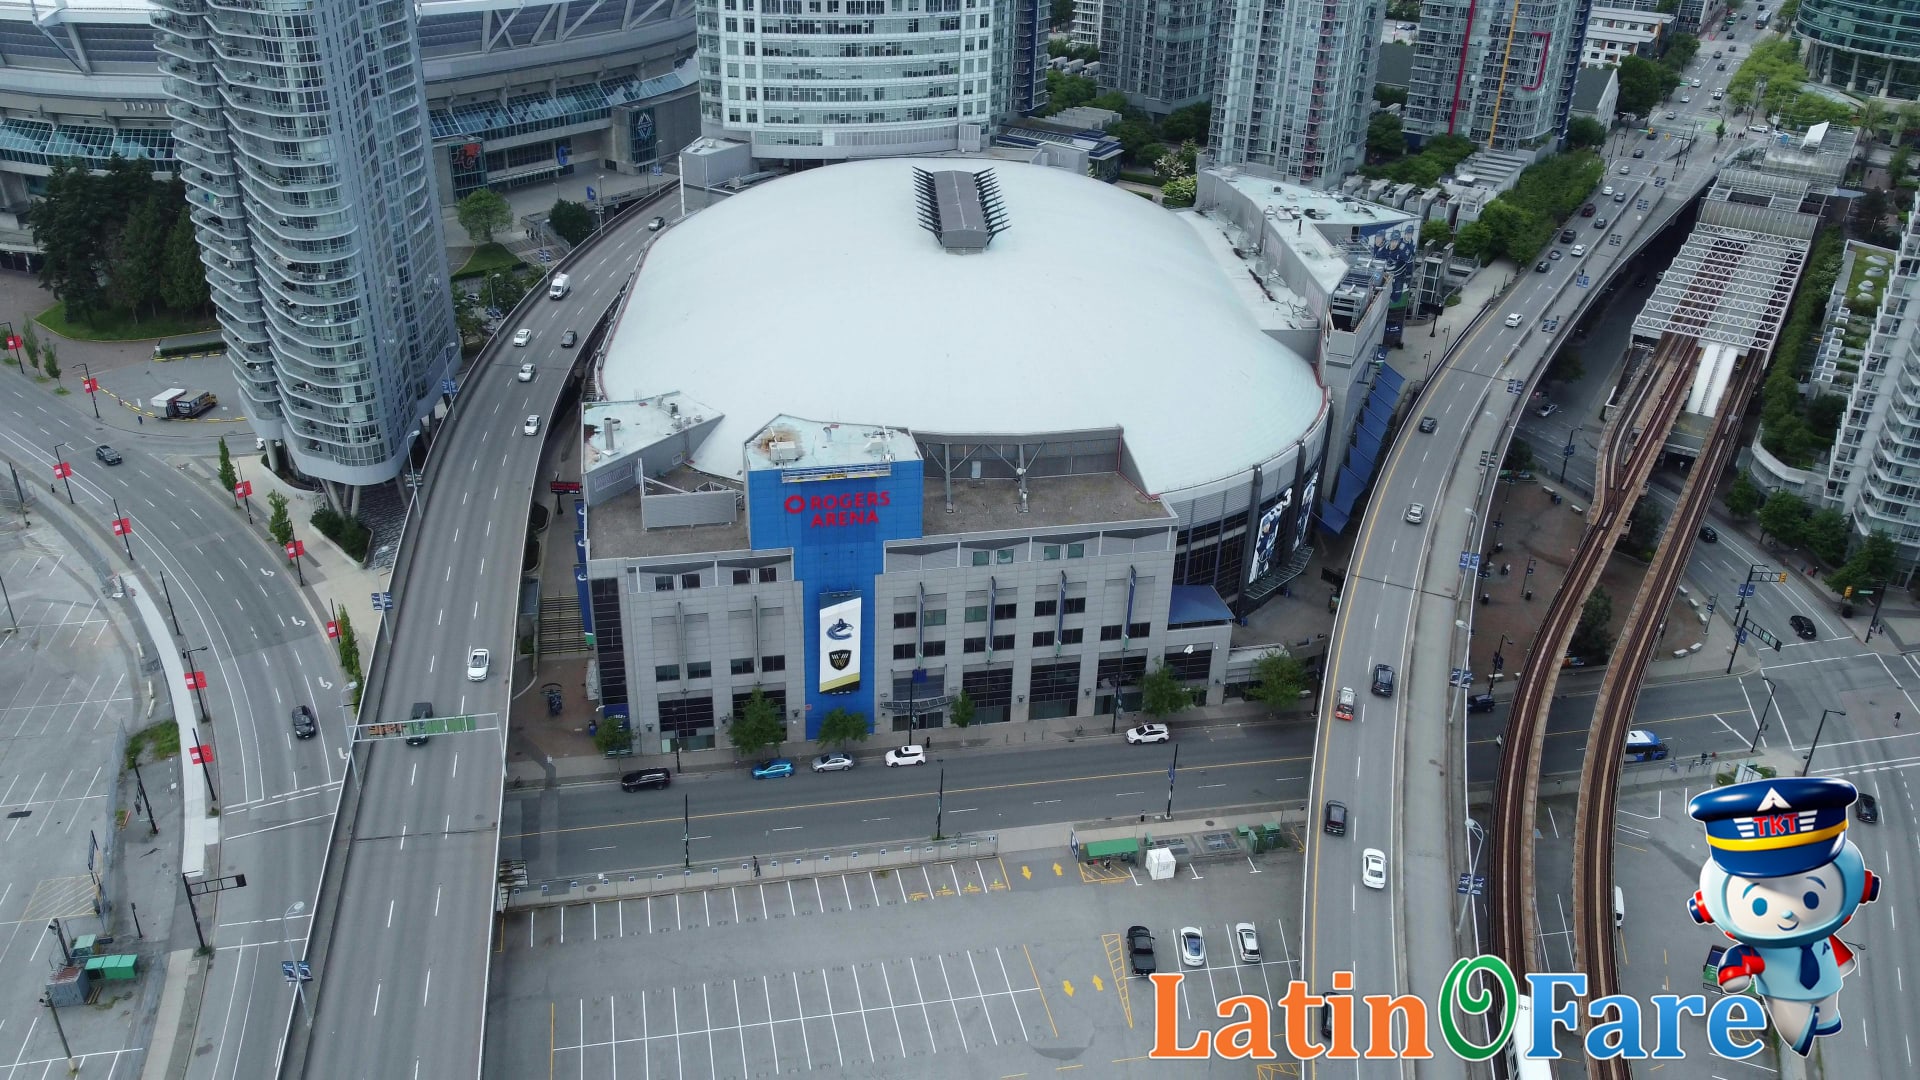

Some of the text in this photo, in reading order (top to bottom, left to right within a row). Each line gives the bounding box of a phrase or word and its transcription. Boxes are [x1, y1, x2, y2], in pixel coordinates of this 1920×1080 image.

[811, 492, 890, 510] ROGERS
[811, 511, 879, 528] ARENA
[1183, 644, 1194, 654] 4
